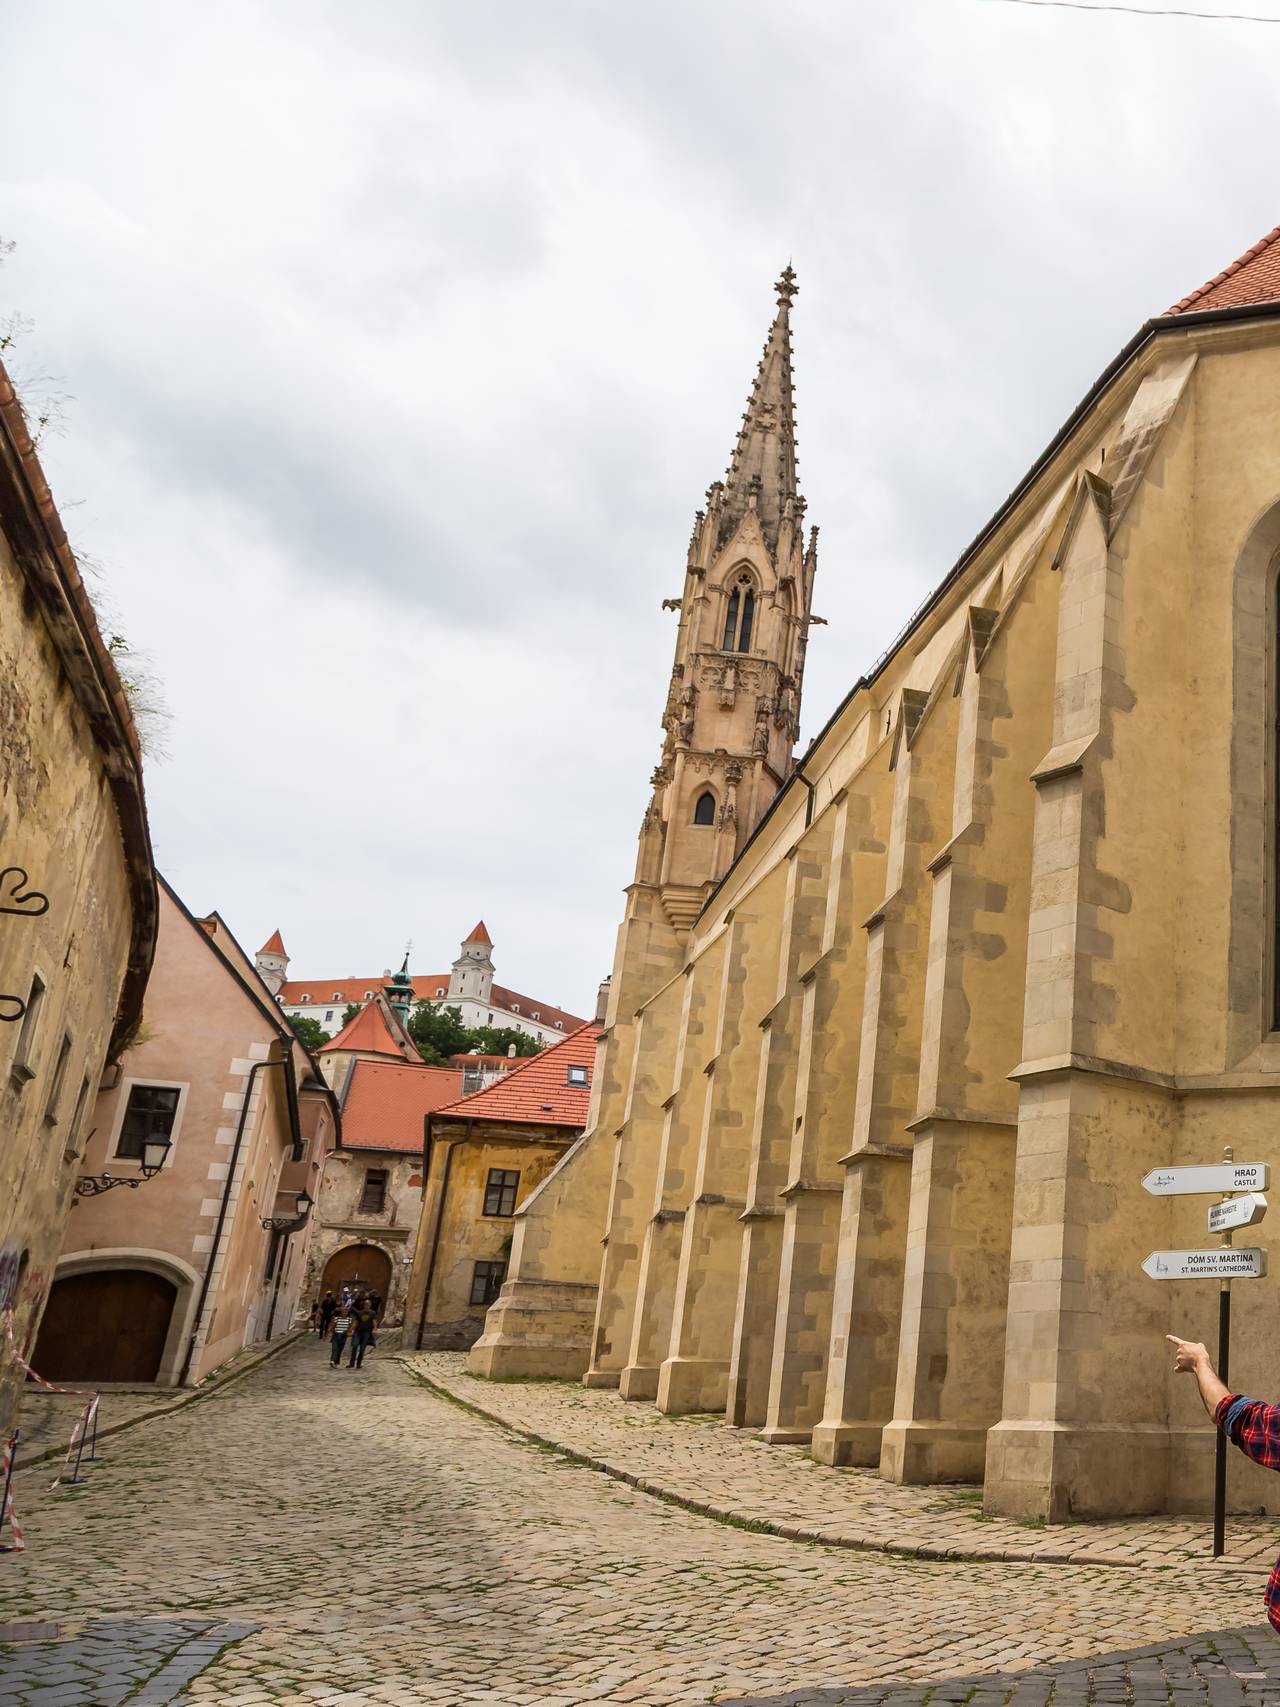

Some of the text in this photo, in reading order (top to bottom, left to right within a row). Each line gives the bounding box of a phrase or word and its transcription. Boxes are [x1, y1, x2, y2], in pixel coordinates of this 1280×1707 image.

[1235, 1169, 1257, 1177] HRAD
[1208, 1255, 1218, 1263] SV.
[1219, 1254, 1254, 1263] MARTINA
